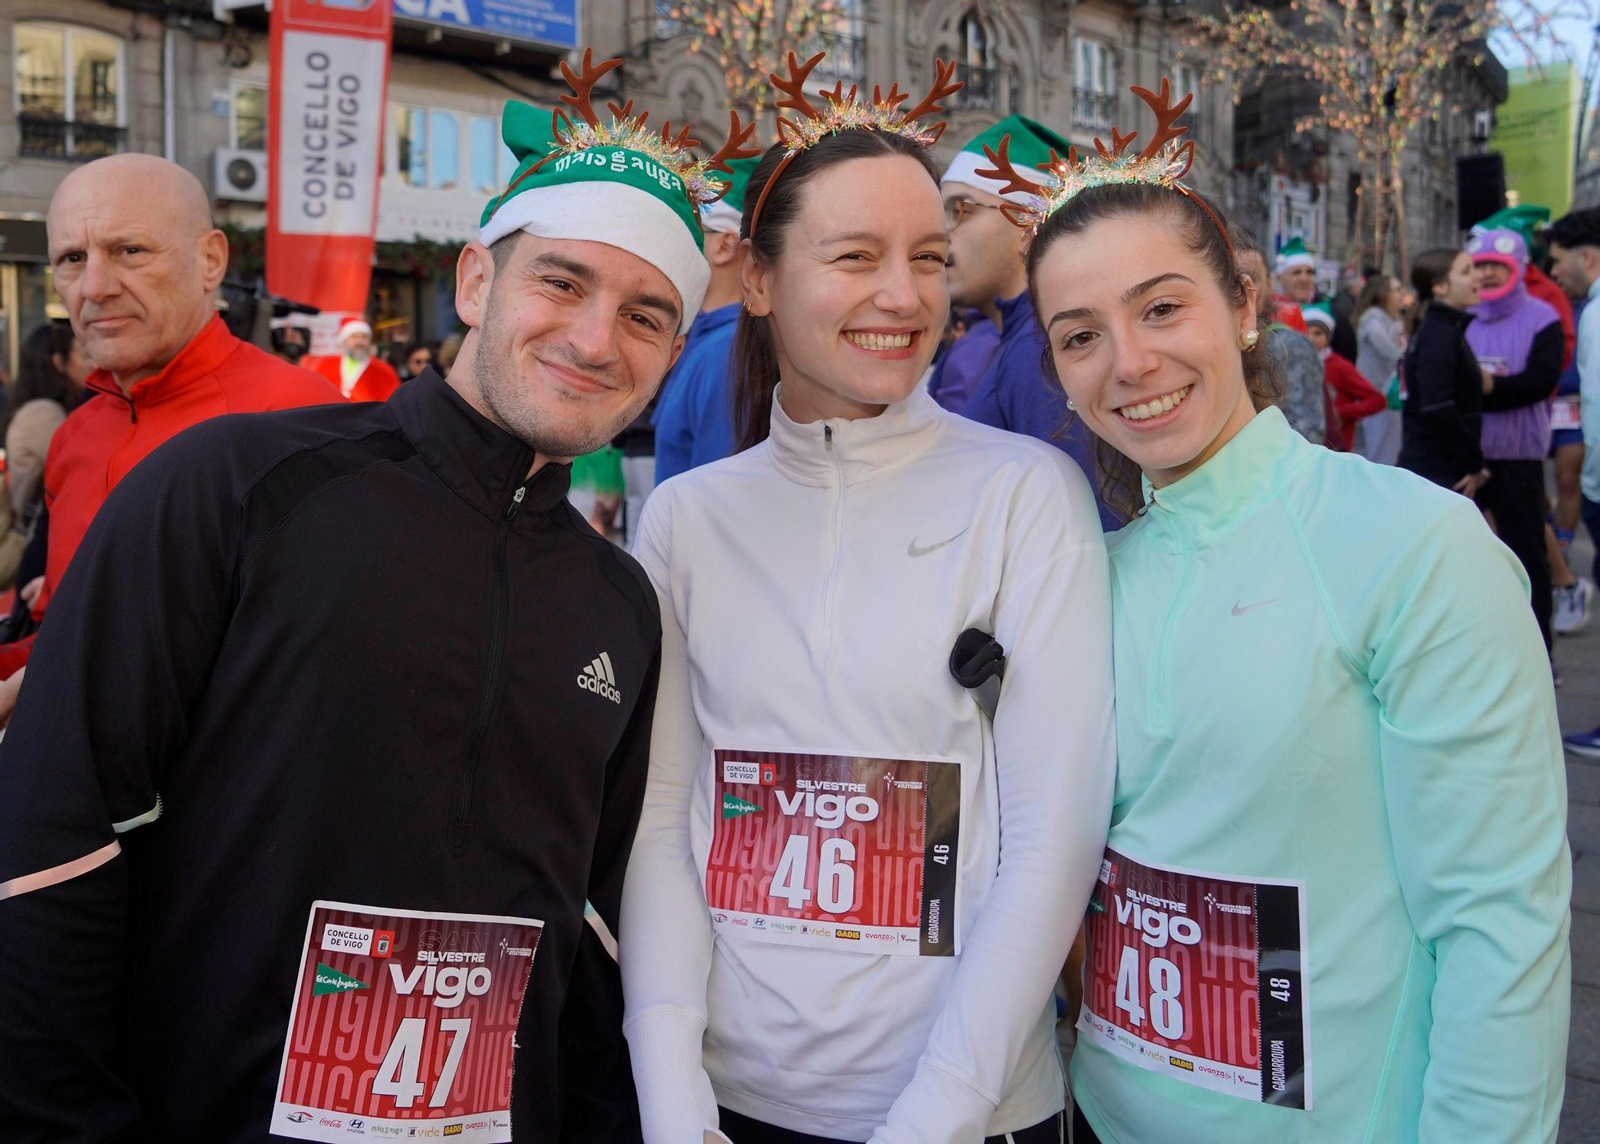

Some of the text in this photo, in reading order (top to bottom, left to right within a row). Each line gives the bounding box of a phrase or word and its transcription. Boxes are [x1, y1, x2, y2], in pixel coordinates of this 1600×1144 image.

[302, 51, 330, 219] CONCELLO
[334, 73, 361, 200] DE VIGO
[631, 157, 682, 190] auga
[577, 674, 621, 704] adidas
[726, 765, 757, 773] CONCELLO
[796, 762, 869, 784] SAN
[796, 780, 867, 793] SILVESTRE
[933, 844, 950, 865] 46
[768, 834, 856, 914] 46
[1126, 887, 1187, 914] SILVESTRE
[928, 899, 940, 944] GARDARROUPA
[327, 929, 369, 941] CONCELLO
[330, 938, 363, 948] DE VIGO
[418, 929, 490, 953] SAN
[836, 930, 860, 939] GADIS
[417, 951, 486, 963] SILVESTRE
[1115, 944, 1184, 1041] 48
[1270, 978, 1291, 1002] 48
[371, 1018, 471, 1108] 47
[1170, 1057, 1193, 1070] GADIS
[1198, 1065, 1225, 1077] avanza
[1271, 1040, 1285, 1091] GARDARROUPA
[418, 1126, 440, 1137] vide
